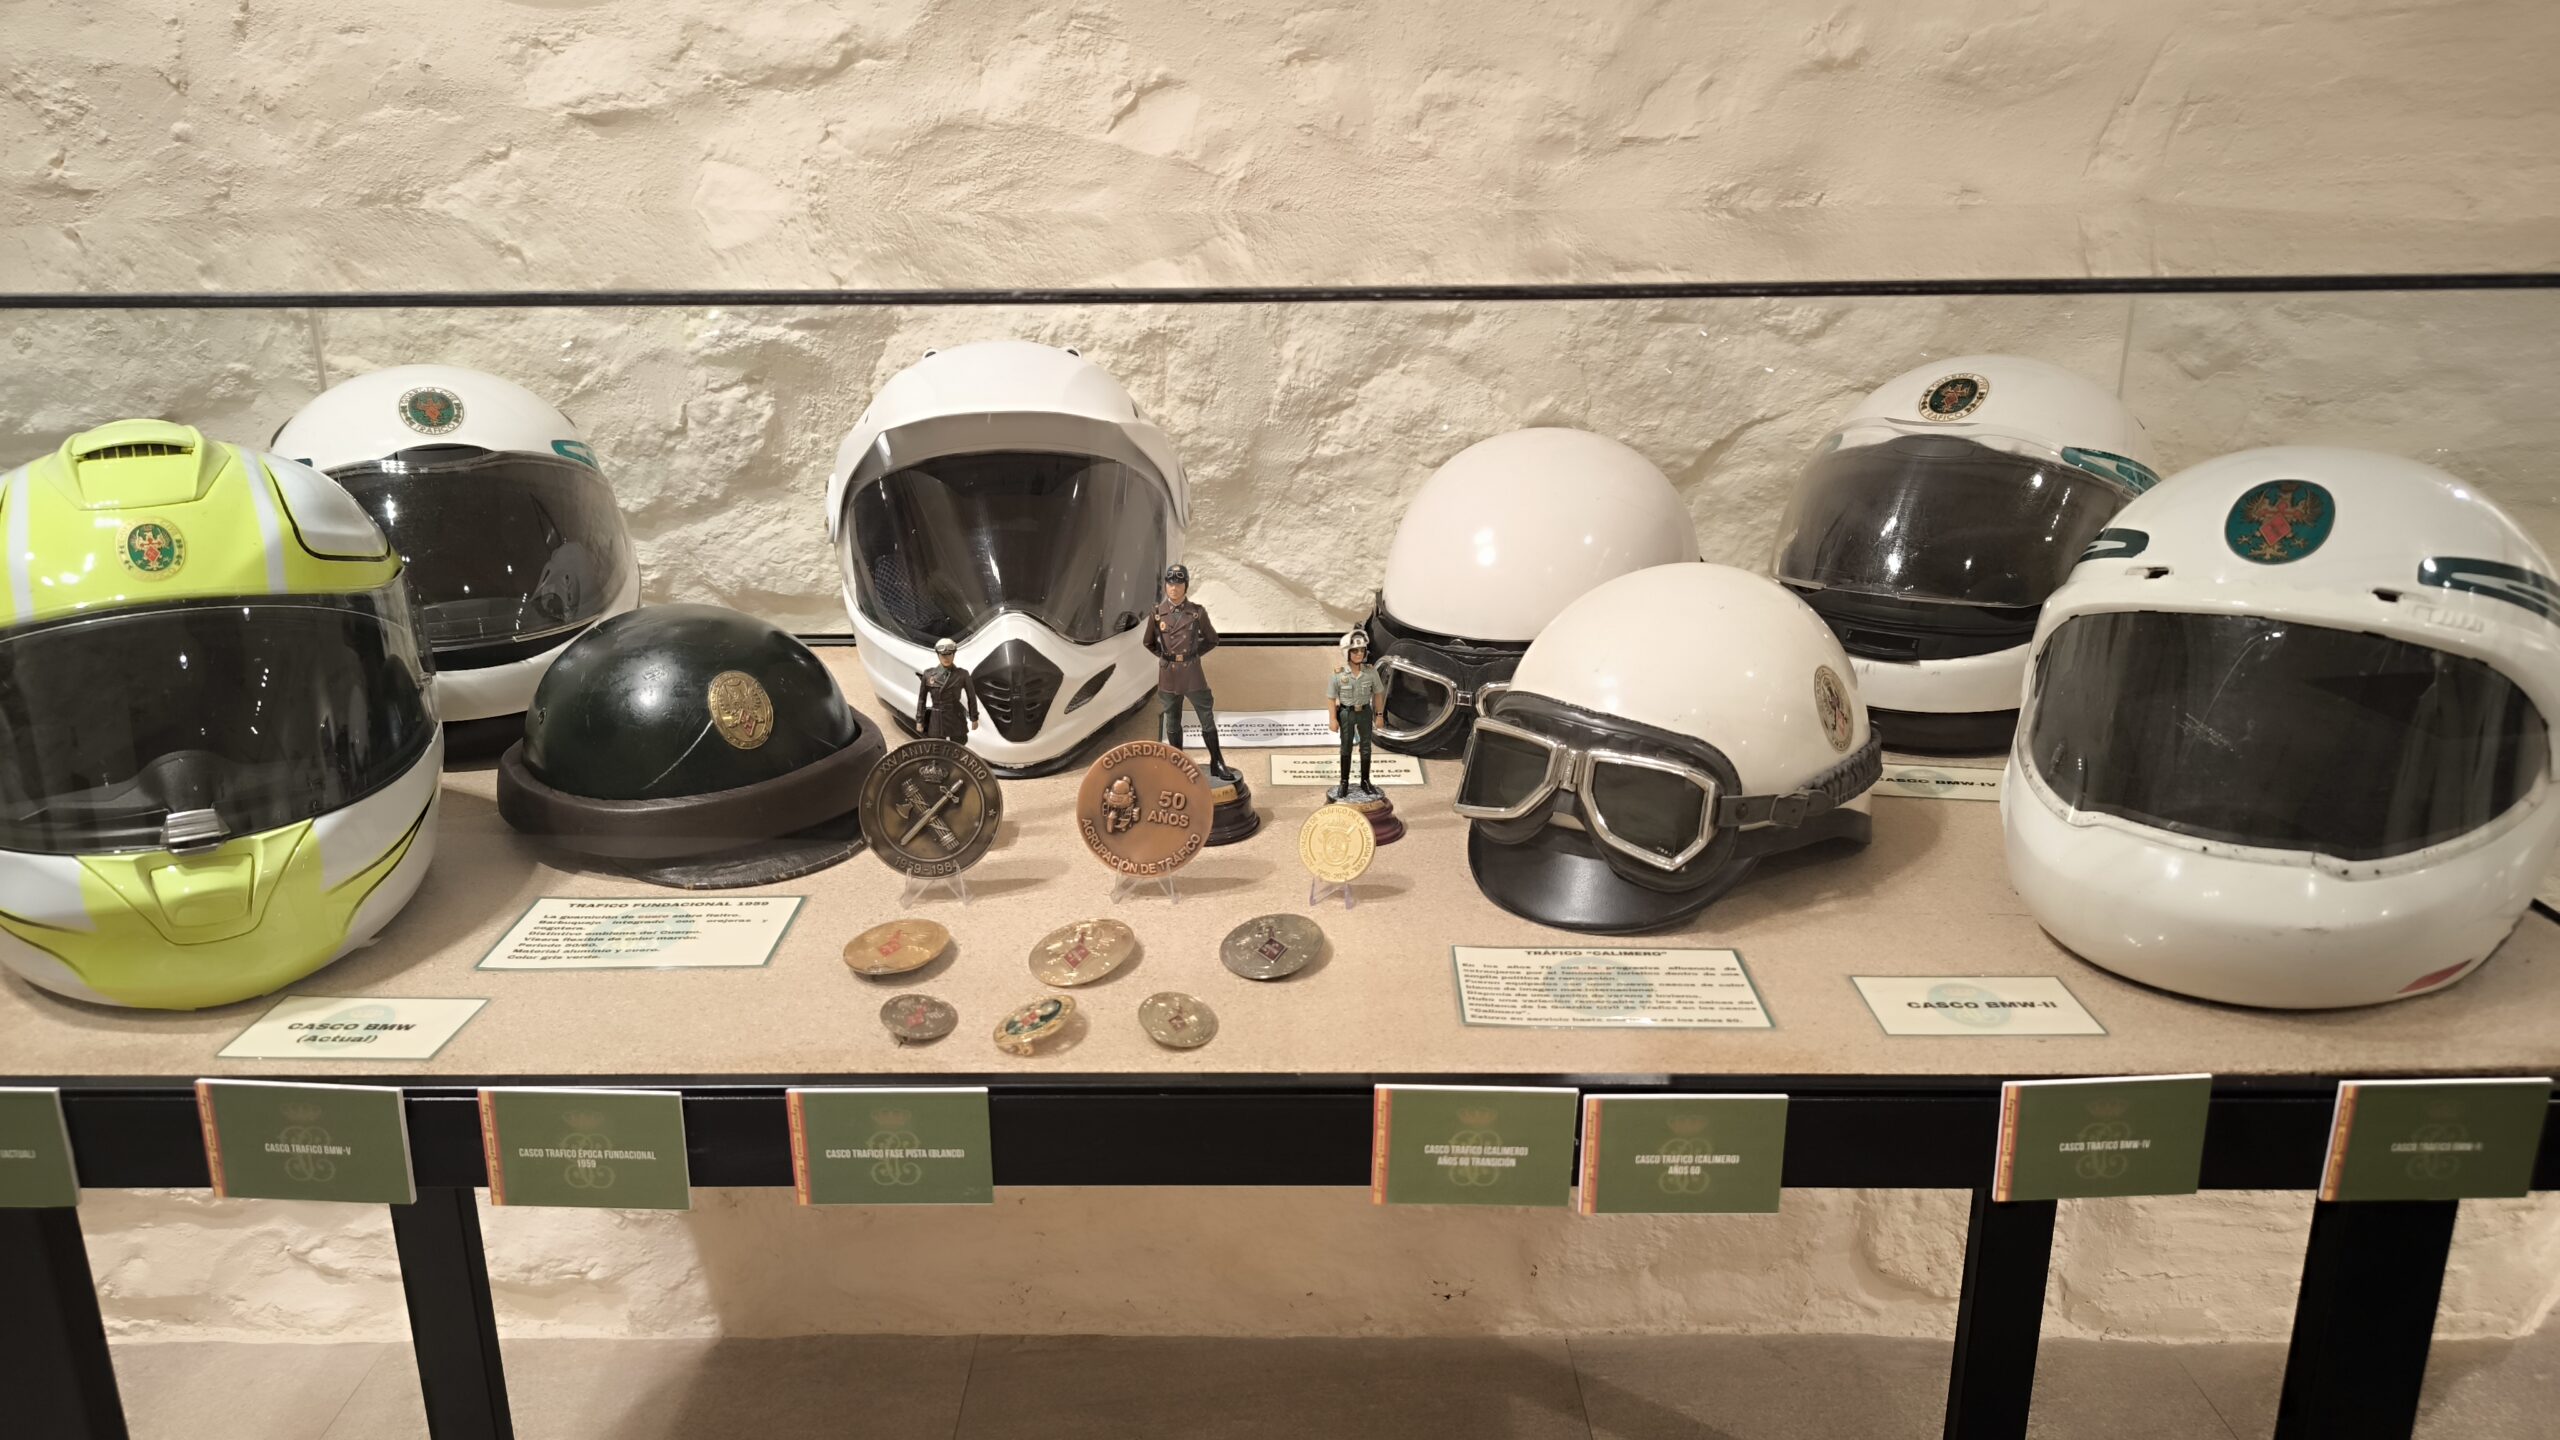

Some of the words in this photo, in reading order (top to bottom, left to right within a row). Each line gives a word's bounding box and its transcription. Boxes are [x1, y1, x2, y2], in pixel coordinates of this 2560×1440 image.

[880, 753, 899, 774] XXV
[901, 743, 988, 780] ANIVERSARIO
[1102, 743, 1168, 770] GUARDIA
[1170, 752, 1200, 784] CIVIL
[1935, 780, 1998, 788] BMW-IV
[1158, 790, 1187, 811] 50
[1147, 809, 1191, 828] AÑOS
[1081, 817, 1139, 874] AGRUPACIÓN
[1140, 863, 1158, 874] DE
[1158, 833, 1202, 870] TRÁFICO
[1906, 1001, 1981, 1010] CASCO
[1984, 1001, 2060, 1010] BMW-II
[287, 1022, 360, 1031] CASCO
[363, 1022, 418, 1031] BMW
[295, 1034, 379, 1044] (Actual)
[264, 1142, 291, 1153] CASCO
[290, 1143, 323, 1154] TRAFICO
[323, 1145, 352, 1156] BMW-V
[1423, 1143, 1451, 1155] CASCO
[2058, 1141, 2085, 1152] CASCO
[2086, 1140, 2120, 1151] TRAFICO
[518, 1147, 545, 1158] CASCO
[544, 1148, 578, 1159] TRAFICO
[603, 1149, 657, 1160] FUNDACIONAL
[825, 1148, 852, 1159] CASCO
[851, 1149, 885, 1159] TRAFICO
[884, 1149, 905, 1159] FASE
[904, 1149, 928, 1159] PISTA
[1634, 1153, 1661, 1165] CASCO
[576, 1159, 597, 1169] 1959
